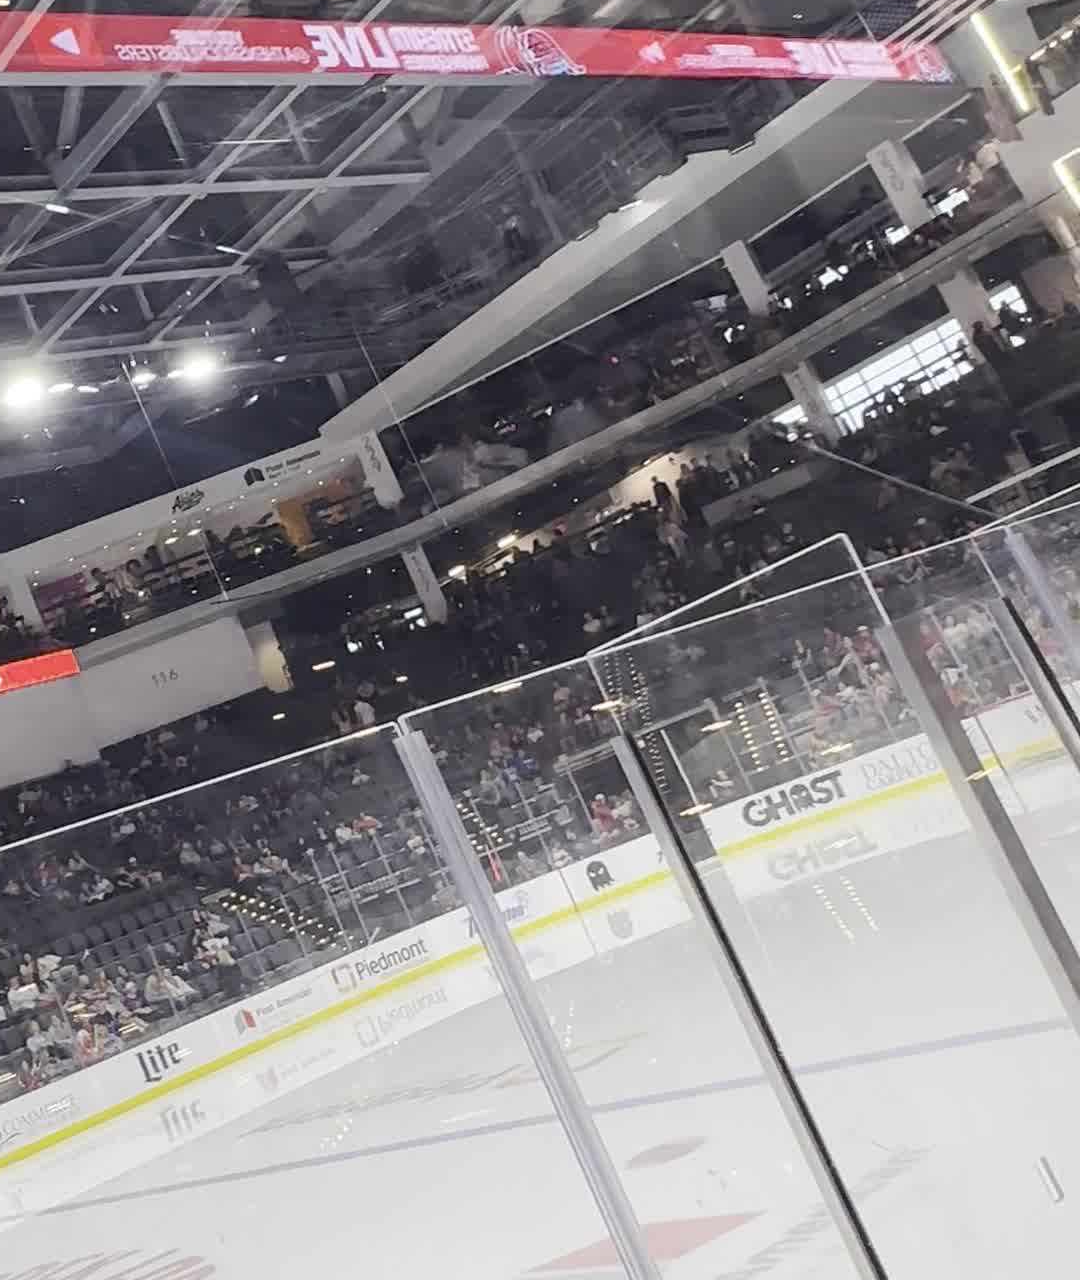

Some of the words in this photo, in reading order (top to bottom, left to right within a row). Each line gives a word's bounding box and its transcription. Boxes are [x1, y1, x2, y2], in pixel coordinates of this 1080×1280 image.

[151, 669, 179, 689] 116
[354, 937, 429, 981] Piedmont
[136, 1041, 183, 1084] Lite
